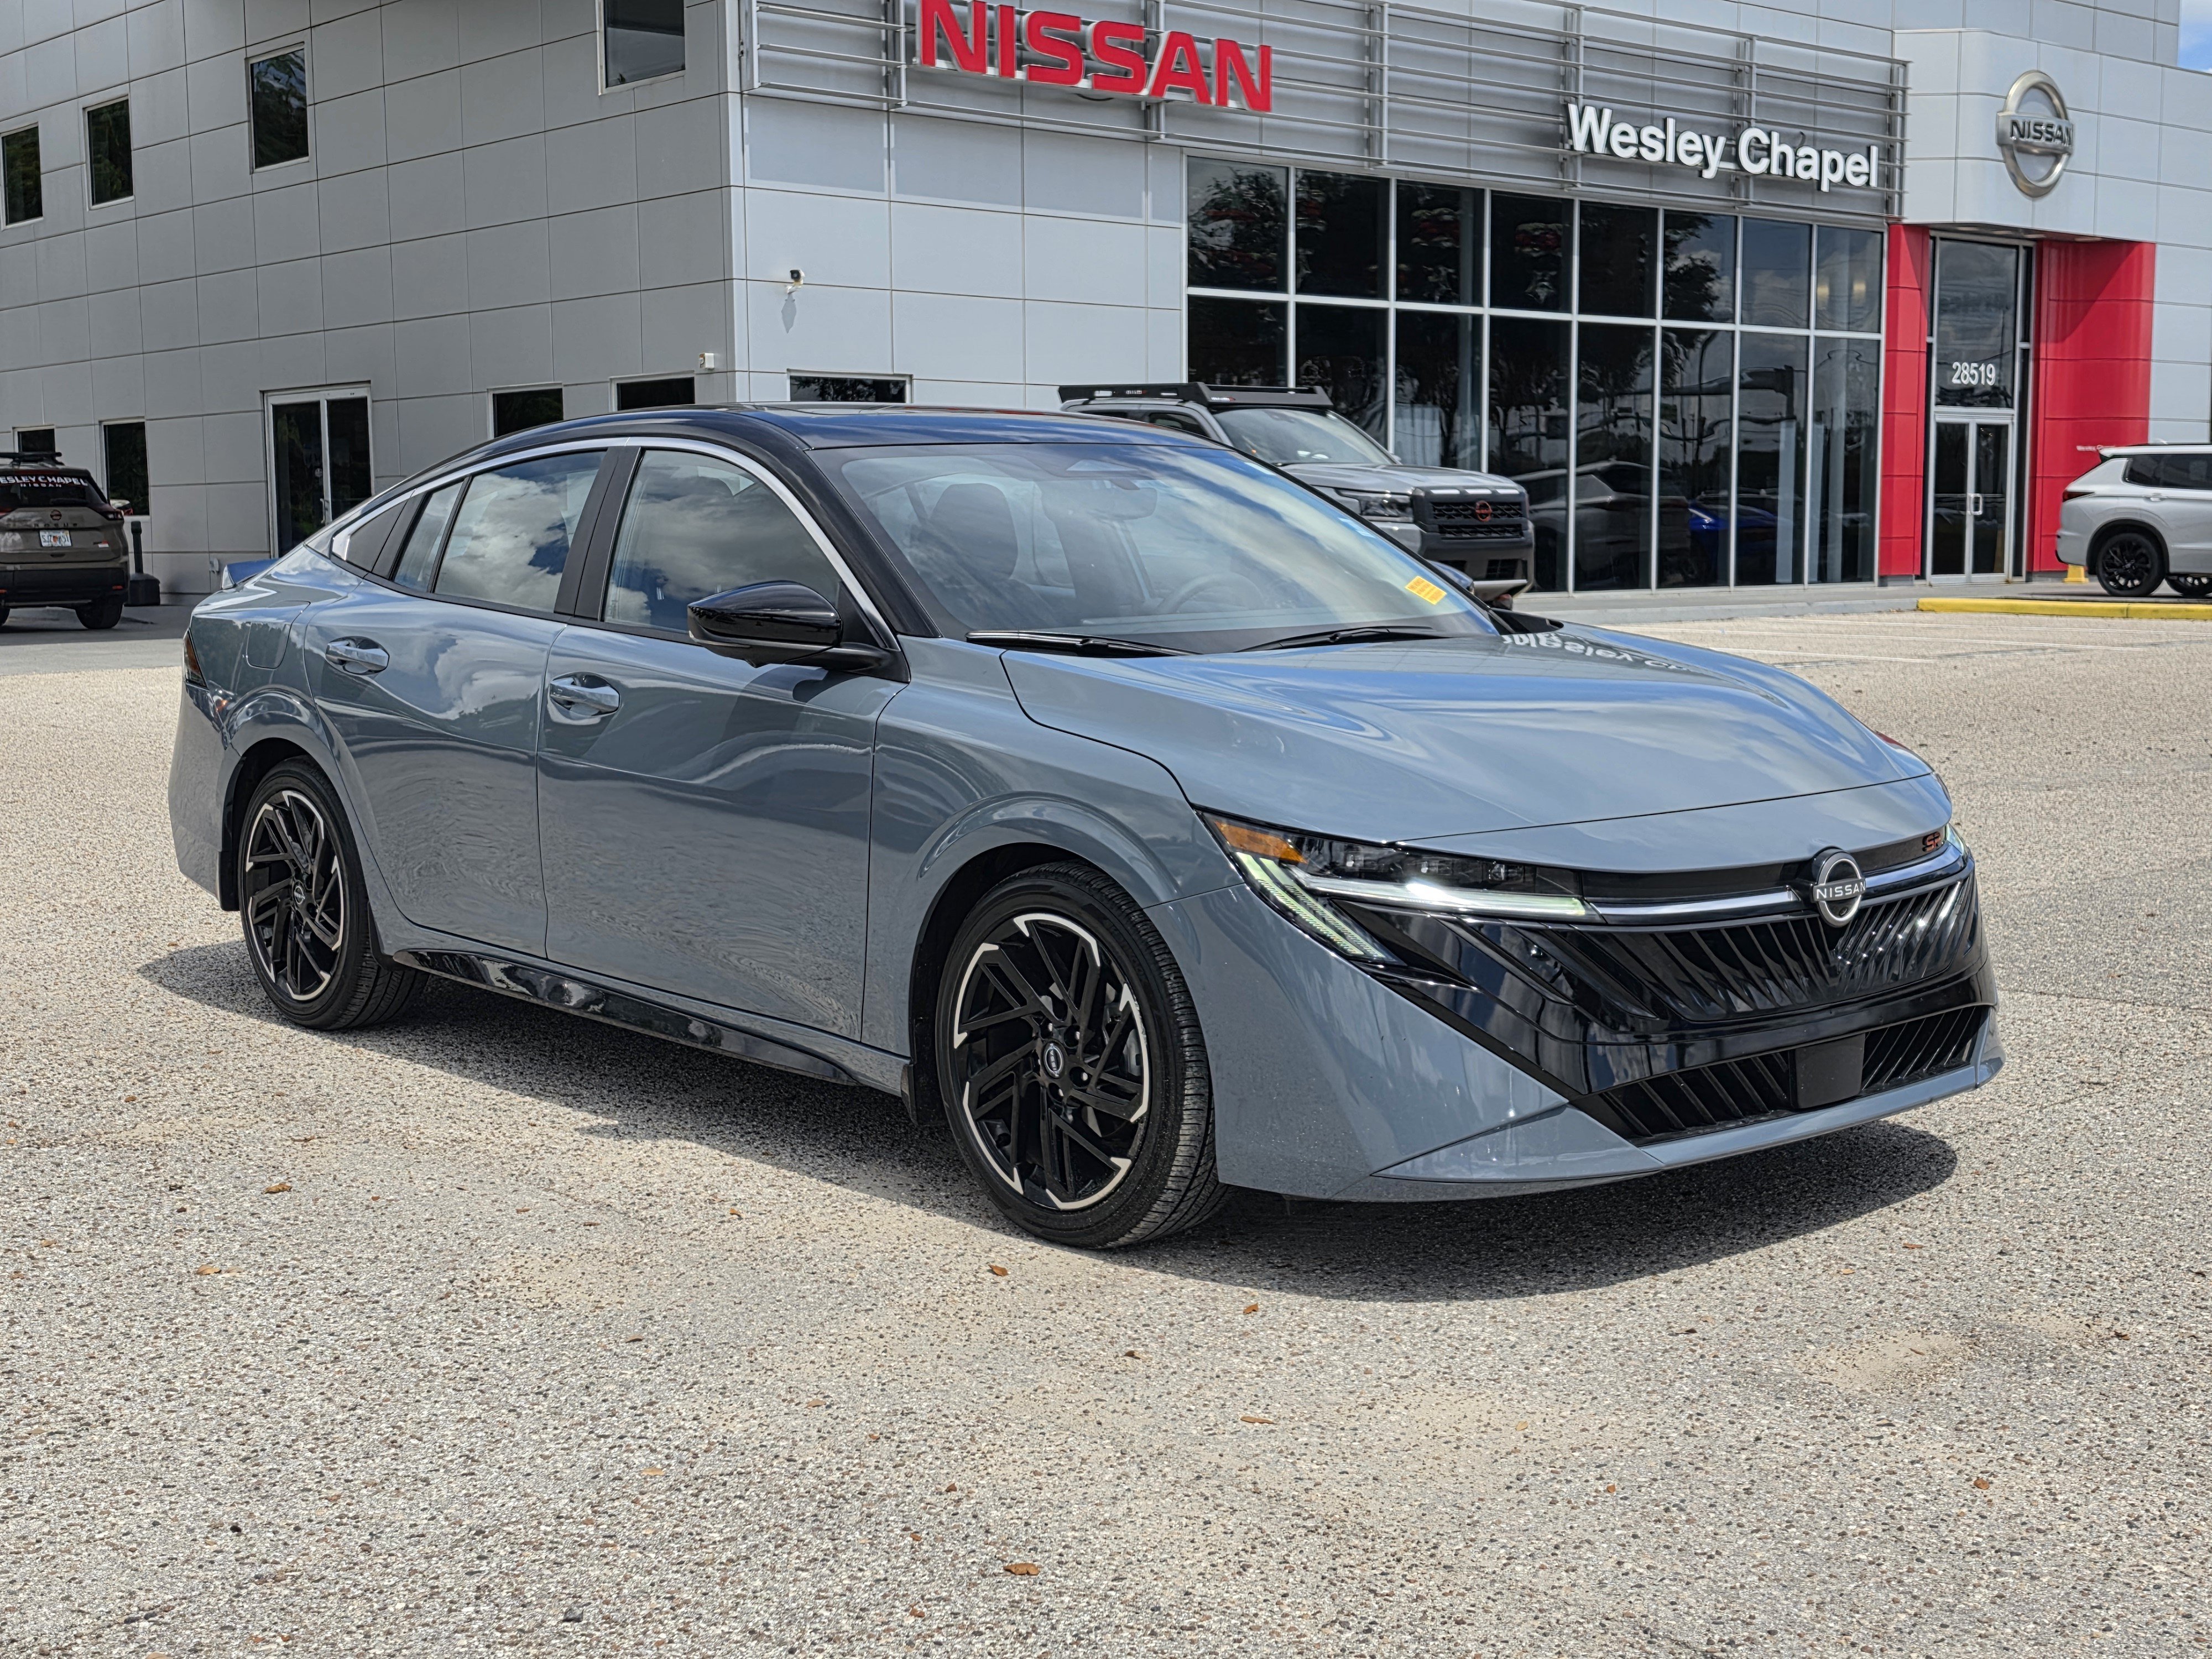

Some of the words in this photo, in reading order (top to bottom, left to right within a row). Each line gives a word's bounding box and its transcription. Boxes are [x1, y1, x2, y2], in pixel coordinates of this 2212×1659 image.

[917, 0, 1271, 112] NISSAN
[2010, 119, 2073, 145] NISSAN
[1567, 103, 1726, 179] Wesley
[1738, 127, 1879, 192] Chapel
[1952, 362, 1996, 386] 28519
[38, 476, 88, 486] CHAPEL
[1816, 880, 1866, 900] NISSAN
